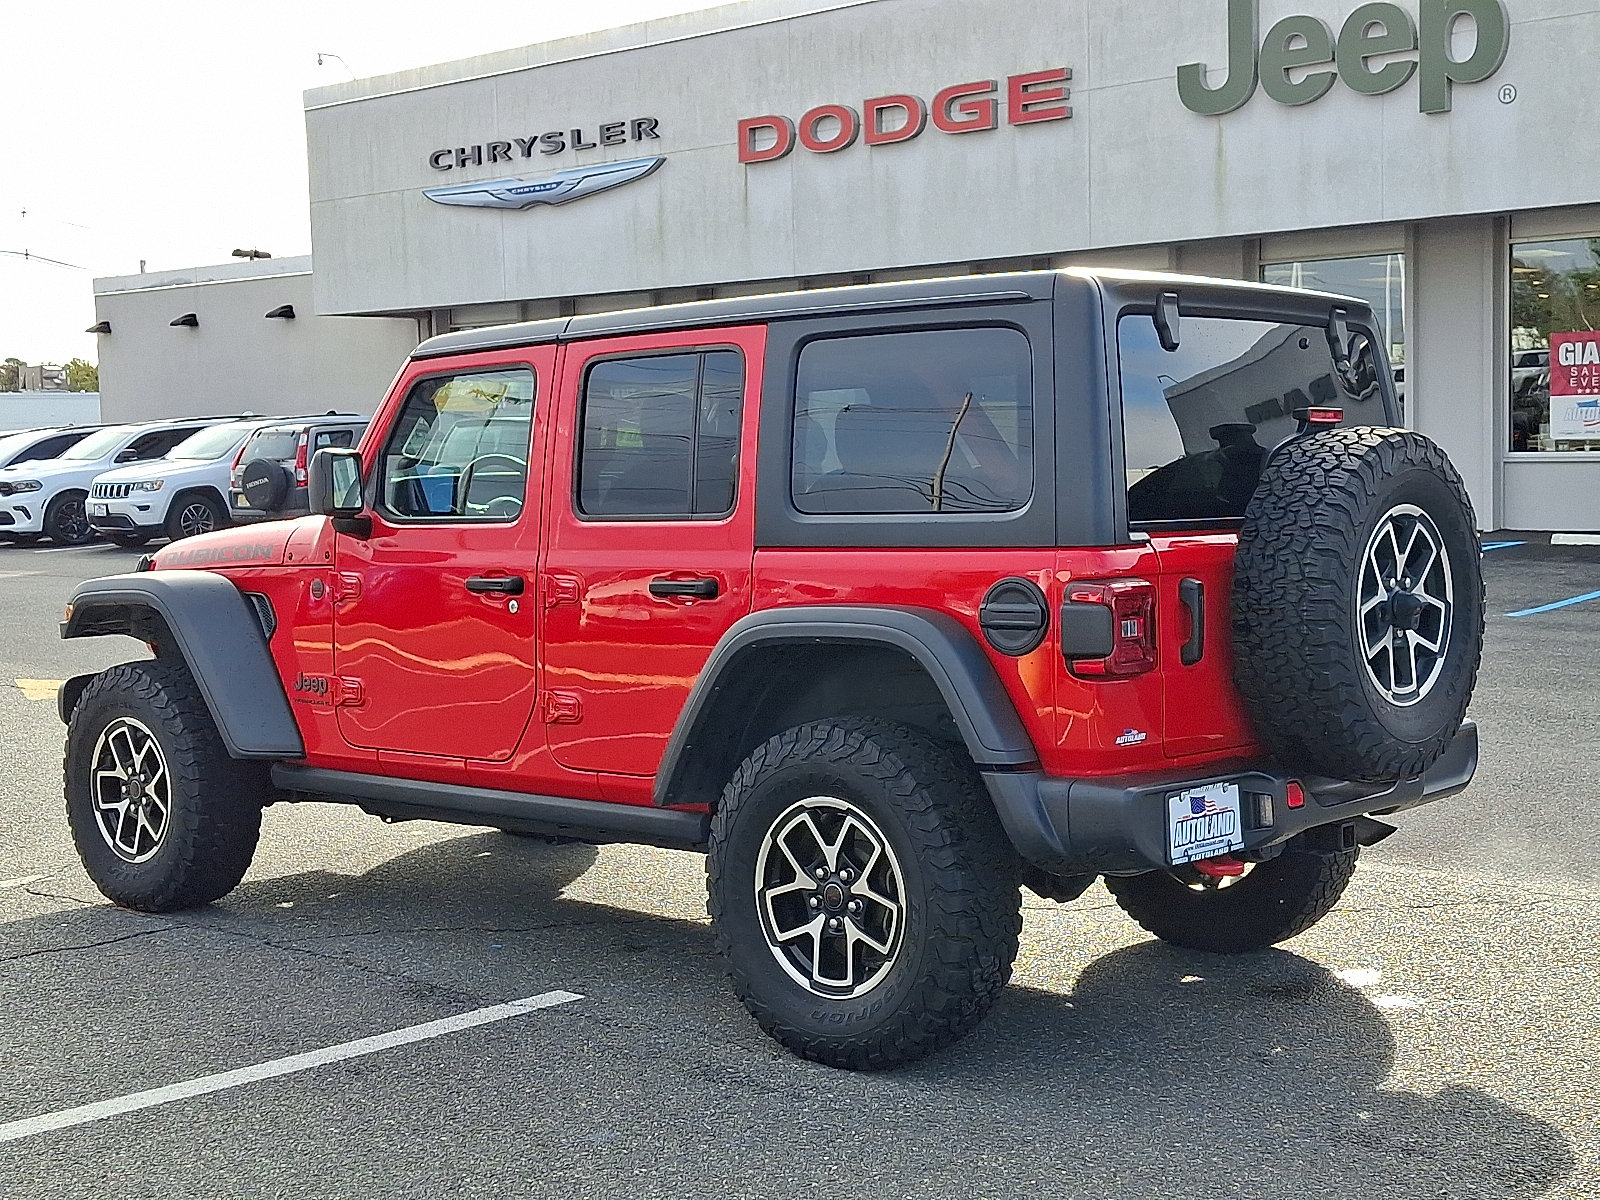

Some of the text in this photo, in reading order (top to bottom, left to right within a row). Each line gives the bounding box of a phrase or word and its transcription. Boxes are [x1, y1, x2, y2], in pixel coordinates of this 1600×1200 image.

[1177, 0, 1510, 115] Jeep
[737, 67, 1073, 165] DODGE
[428, 117, 661, 171] CHRYSLER
[511, 183, 557, 194] CHRYSLER
[246, 477, 269, 489] HONDA
[161, 543, 274, 565] RUBICON
[295, 671, 328, 697] Jeep
[1115, 732, 1147, 745] AUTOLAND
[1174, 809, 1236, 849] AUTOLAND
[1190, 846, 1229, 862] AUTOLAND
